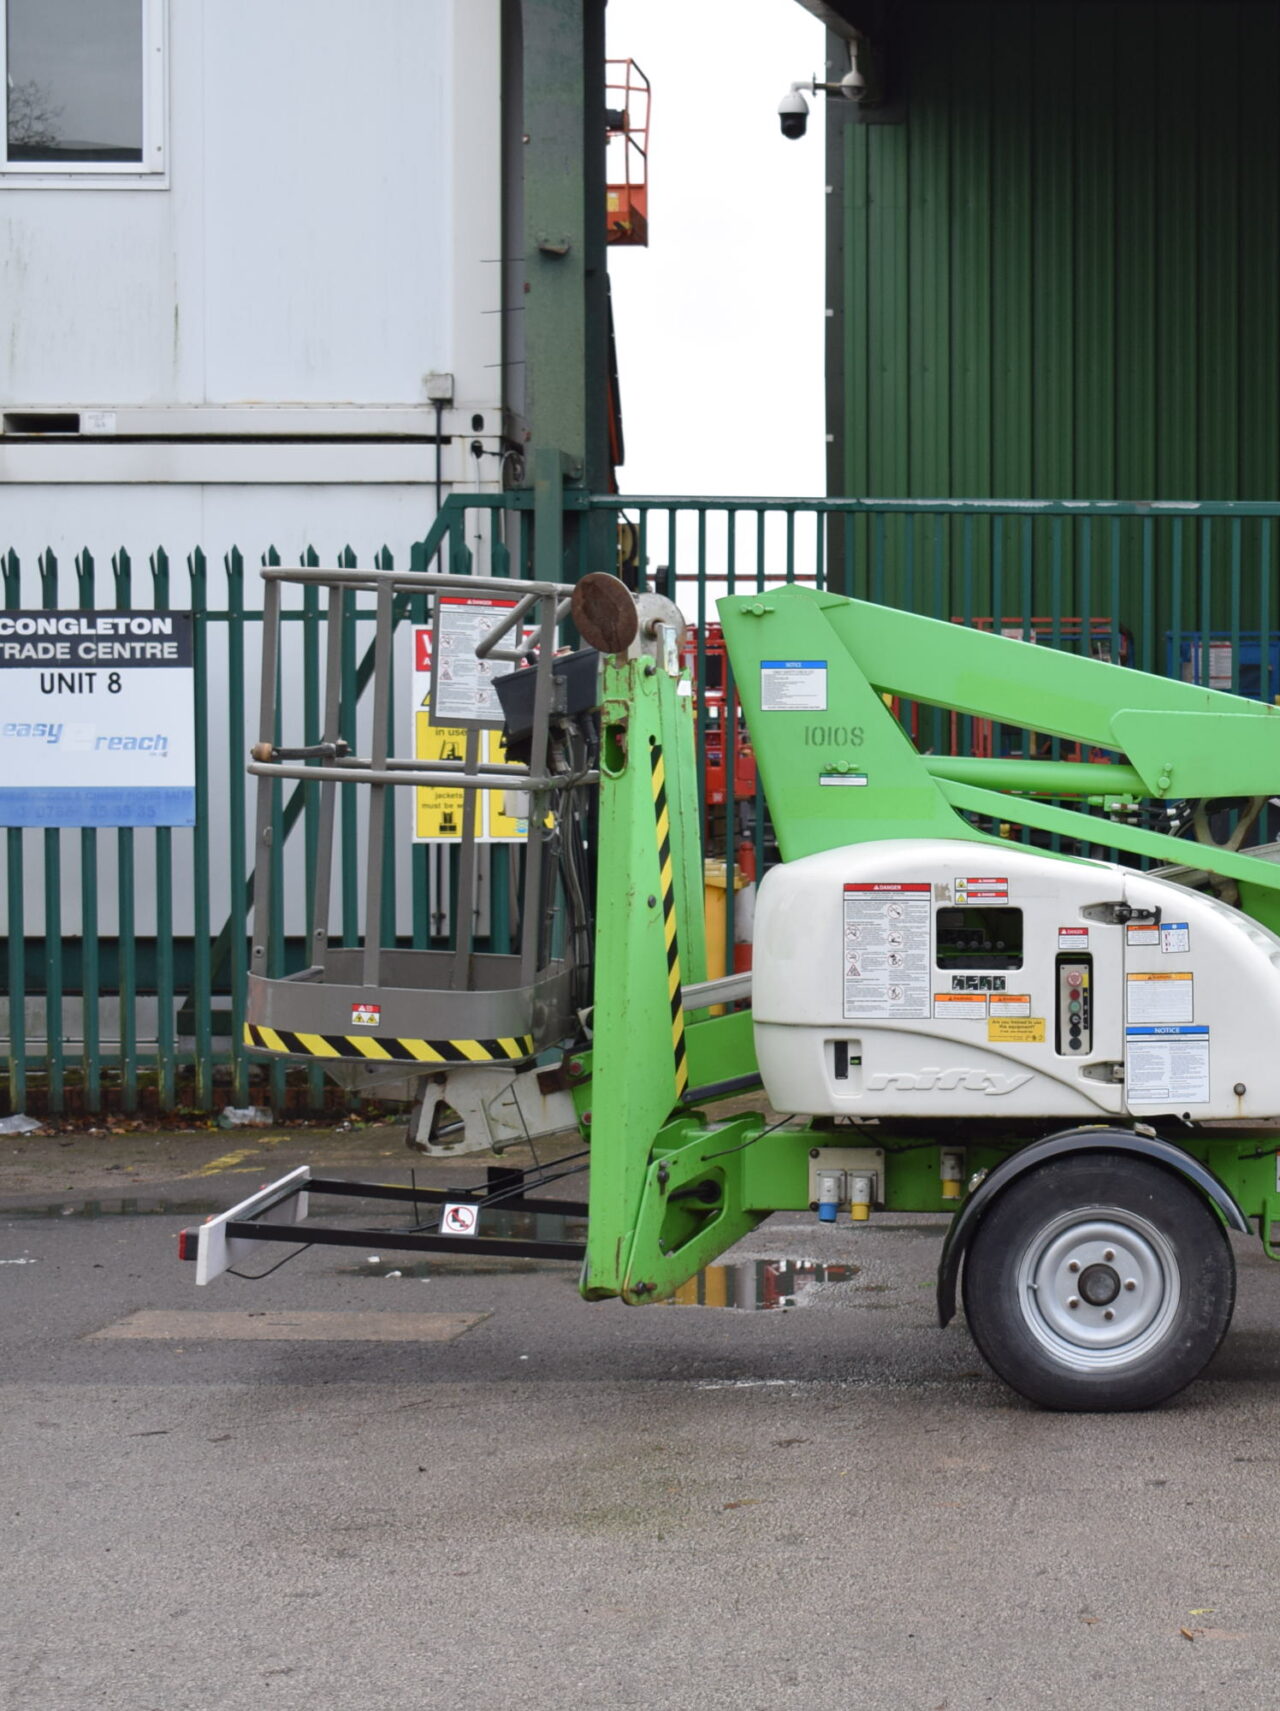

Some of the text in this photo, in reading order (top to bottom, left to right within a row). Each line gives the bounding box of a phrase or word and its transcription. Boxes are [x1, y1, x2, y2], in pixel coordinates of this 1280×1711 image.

[0, 617, 173, 636] CONGLETON
[0, 642, 178, 659] RADE CENTRE
[40, 672, 122, 694] UNIT 8
[2, 723, 63, 744] easy
[94, 734, 168, 751] reach
[866, 1067, 1036, 1096] nifty
